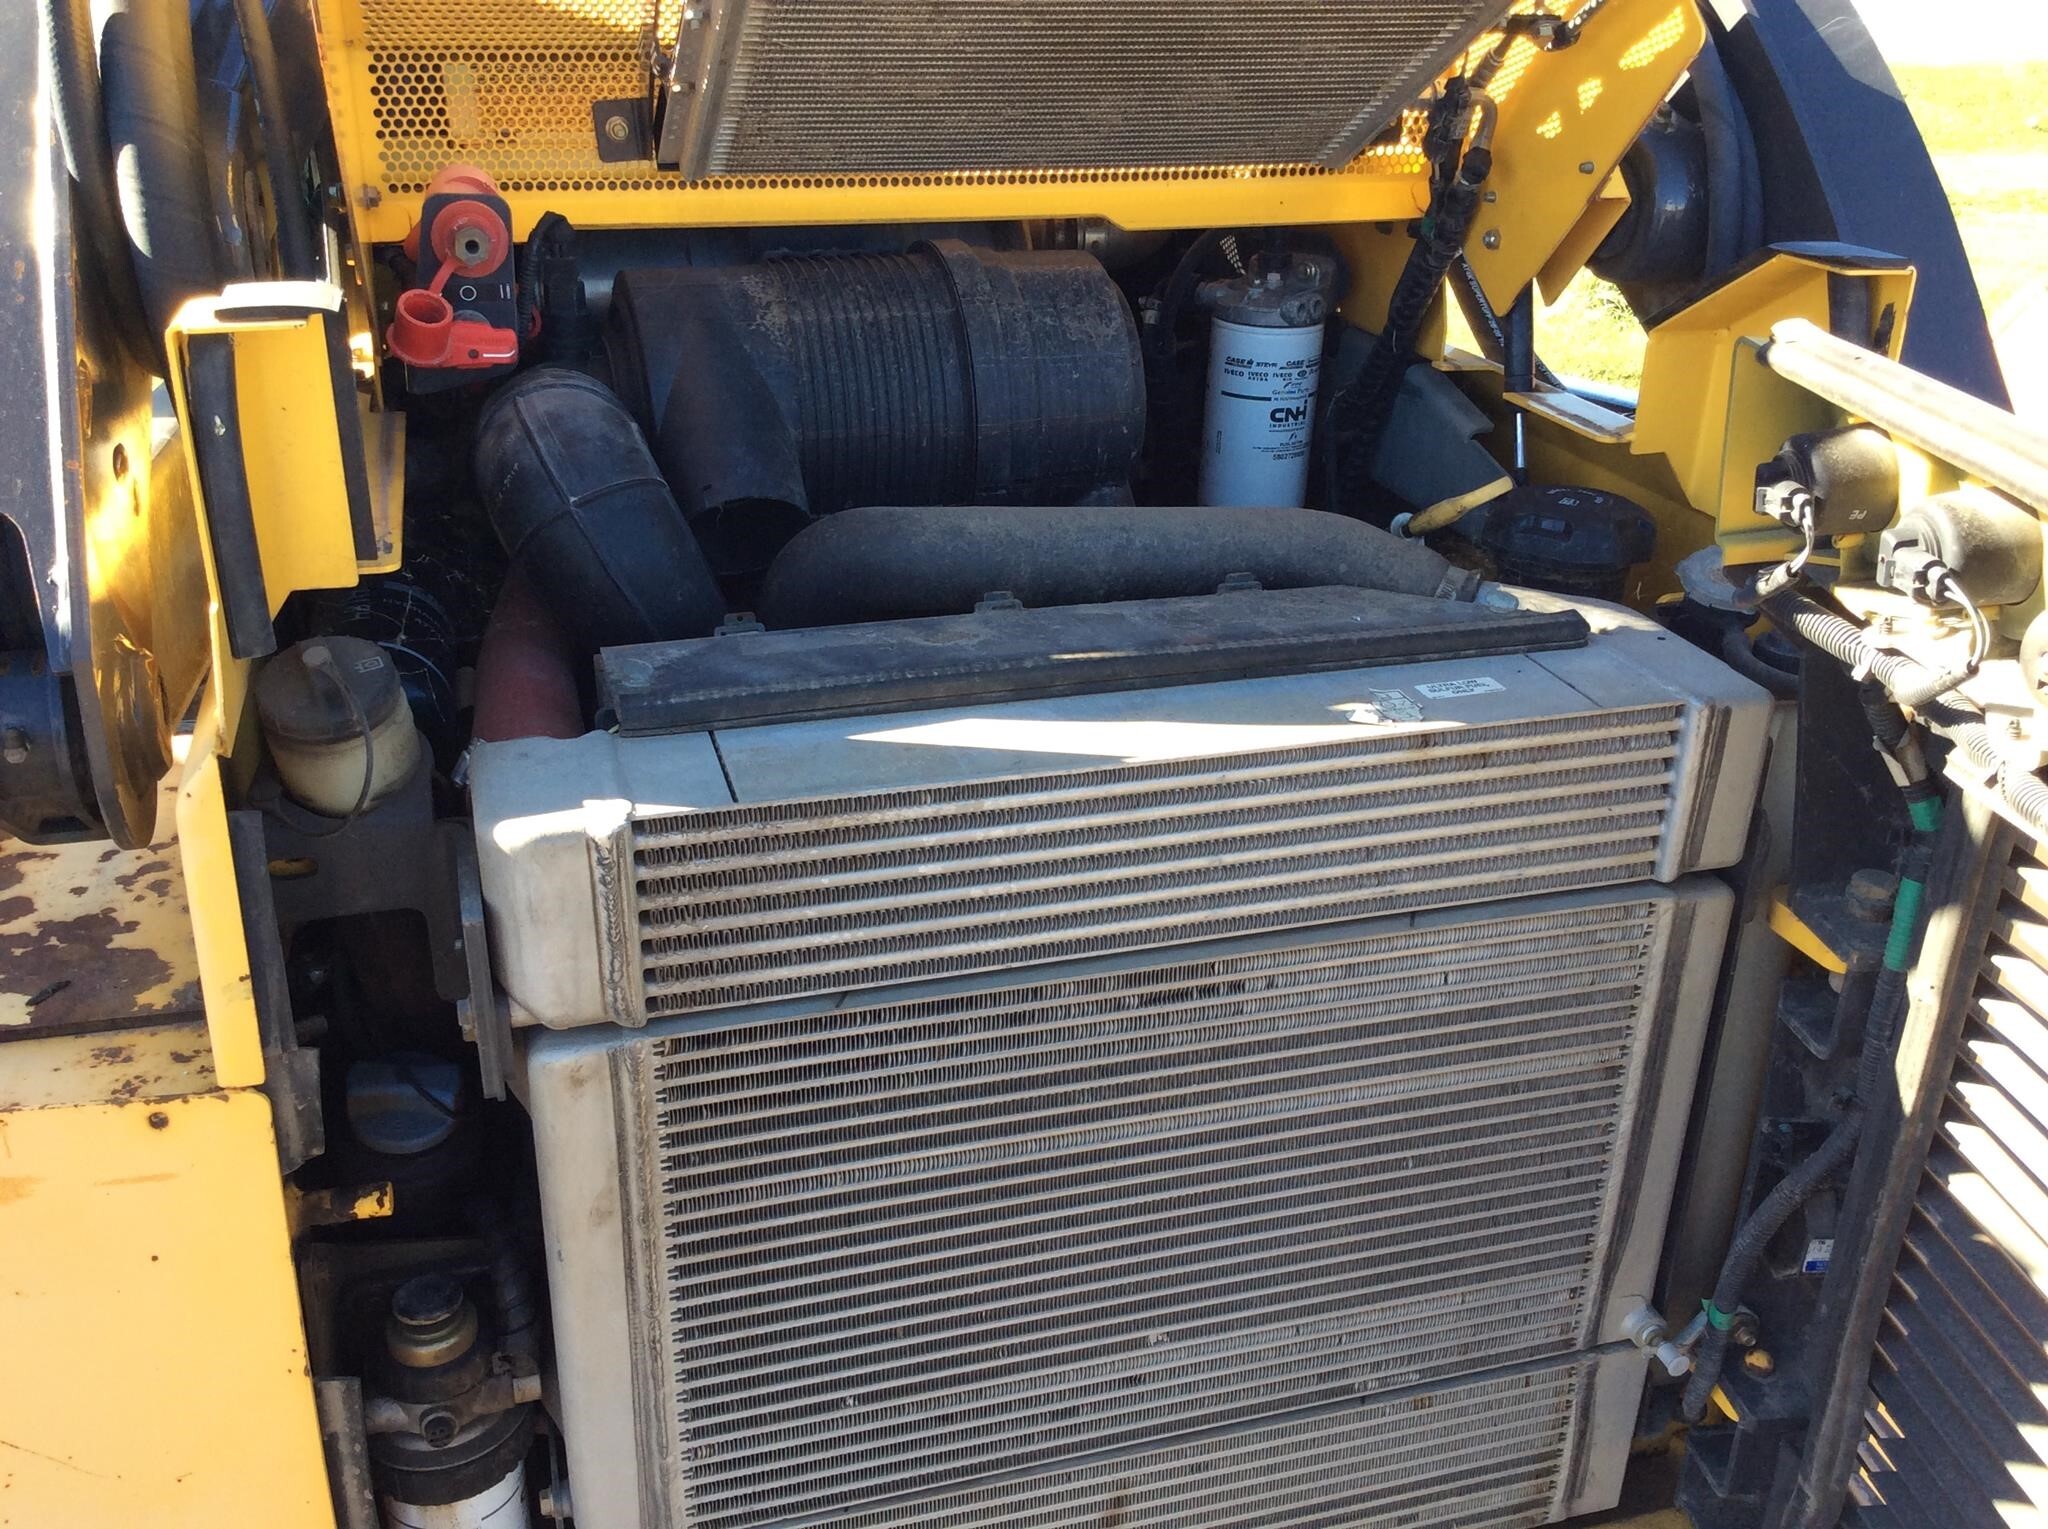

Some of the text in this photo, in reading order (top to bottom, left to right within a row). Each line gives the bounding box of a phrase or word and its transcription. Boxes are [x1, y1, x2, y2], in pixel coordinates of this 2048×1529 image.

[1226, 356, 1246, 364] CASE
[1224, 368, 1245, 377] IVECO
[1270, 400, 1308, 423] CNH
